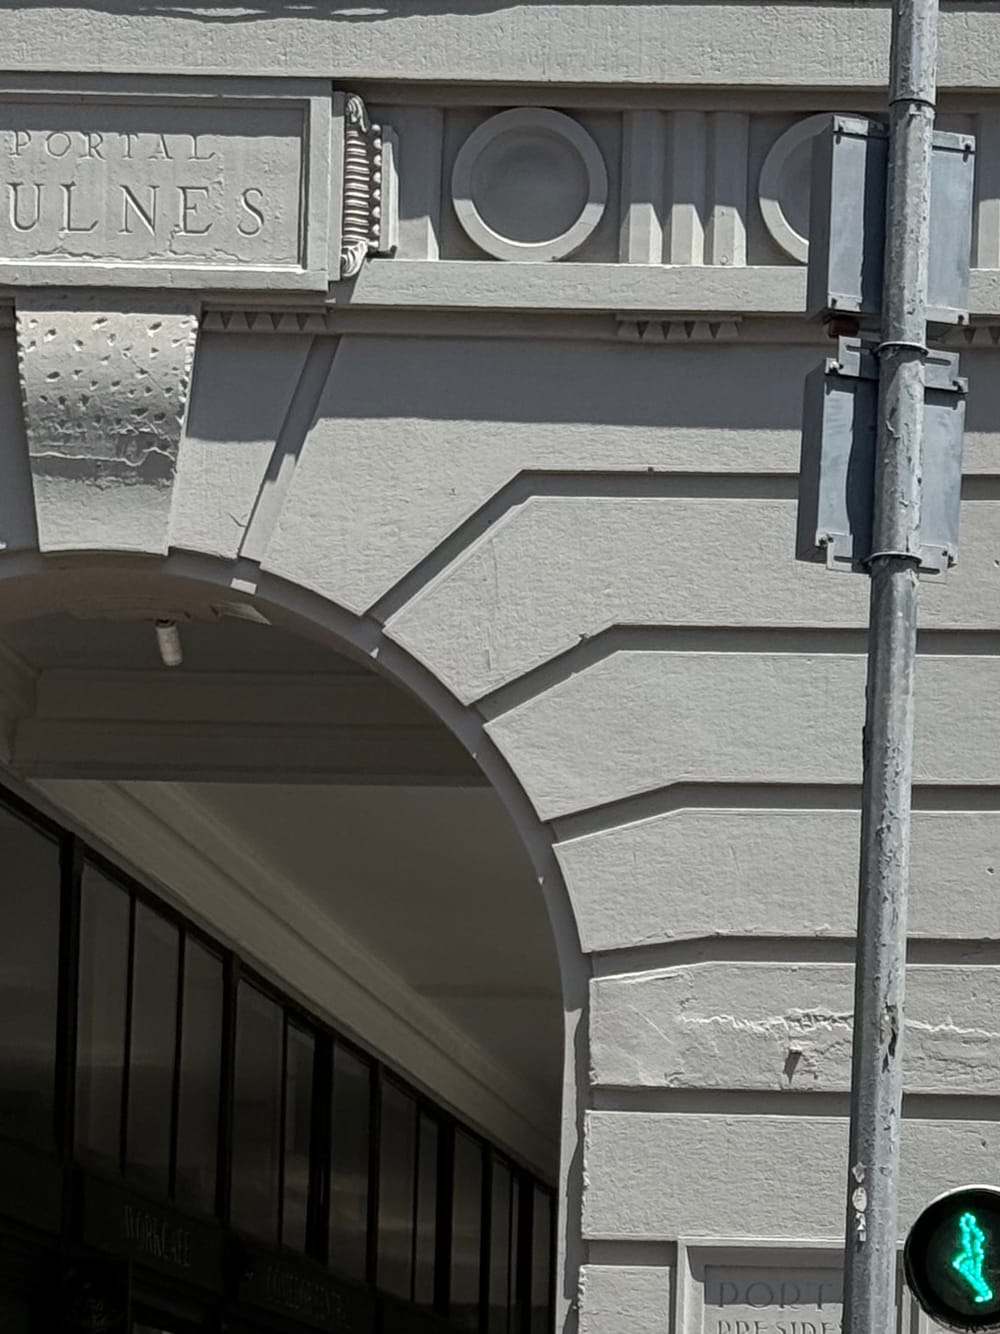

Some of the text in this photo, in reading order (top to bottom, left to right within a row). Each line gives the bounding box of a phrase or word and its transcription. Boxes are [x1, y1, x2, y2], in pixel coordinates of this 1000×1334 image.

[8, 129, 216, 161] PORTAL
[6, 181, 266, 237] ULNES
[717, 1280, 834, 1312] PORT
